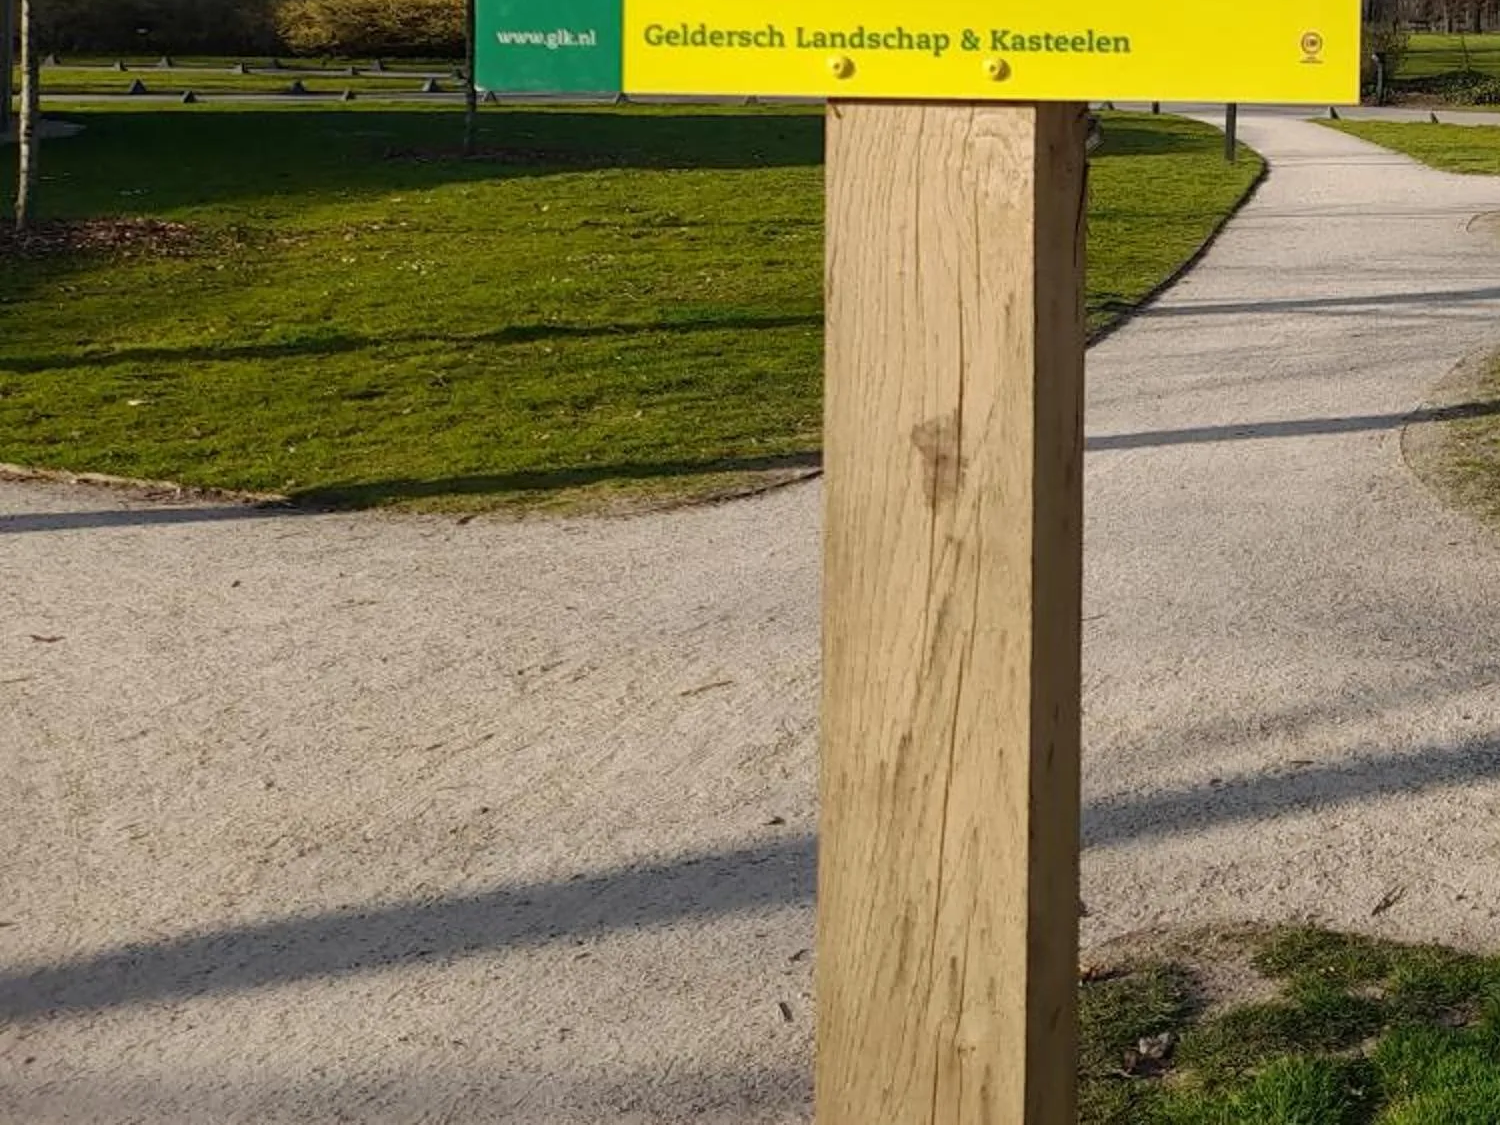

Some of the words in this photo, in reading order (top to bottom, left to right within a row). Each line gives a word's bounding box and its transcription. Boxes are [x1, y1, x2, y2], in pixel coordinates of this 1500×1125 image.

[497, 29, 596, 49] www.glk.nl
[644, 23, 785, 47] Geldersch
[796, 26, 950, 56] Landschap
[960, 27, 980, 51] &
[991, 30, 1131, 55] Kasteelen
